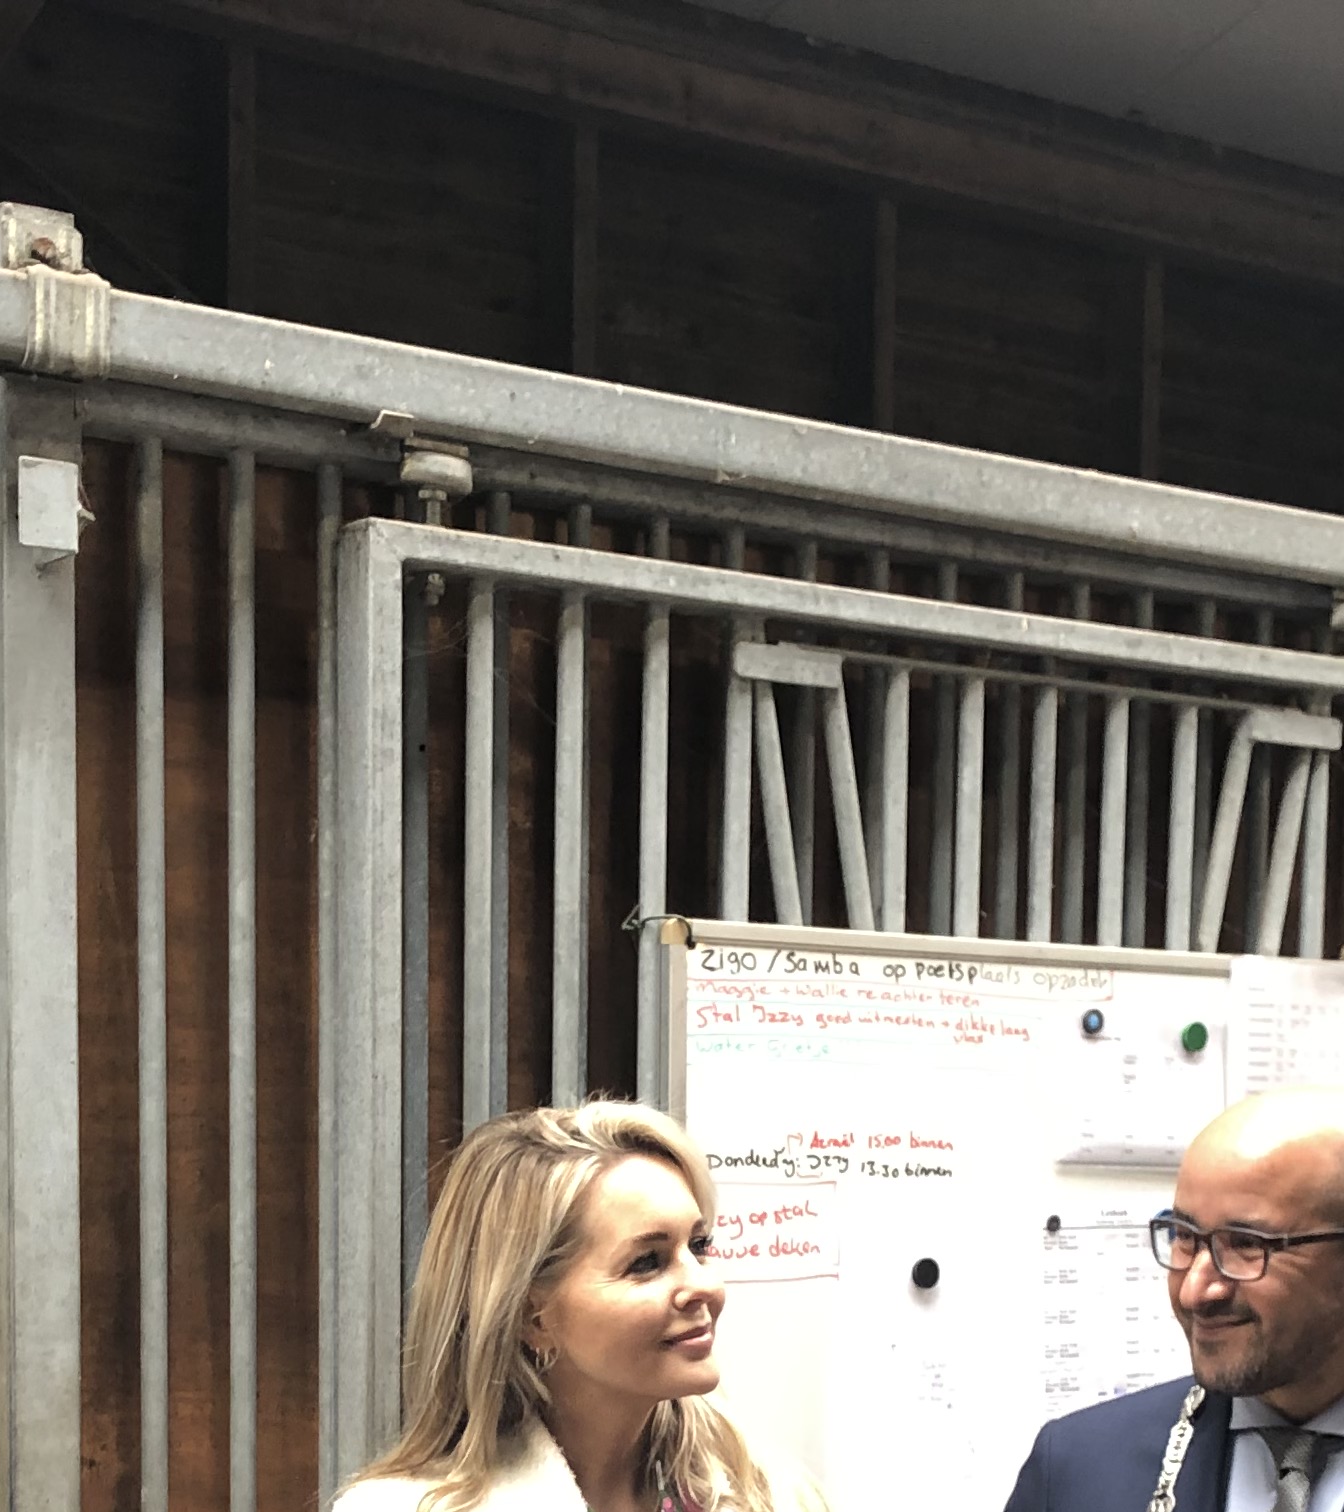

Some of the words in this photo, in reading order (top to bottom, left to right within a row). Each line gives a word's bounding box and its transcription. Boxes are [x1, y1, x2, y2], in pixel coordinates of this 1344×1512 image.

[883, 964, 906, 984] op
[696, 1002, 740, 1028] Stal
[910, 1131, 954, 1150] binnen
[861, 1161, 899, 1178] 13.30
[905, 1162, 953, 1178] binnen
[717, 1214, 744, 1240] zy
